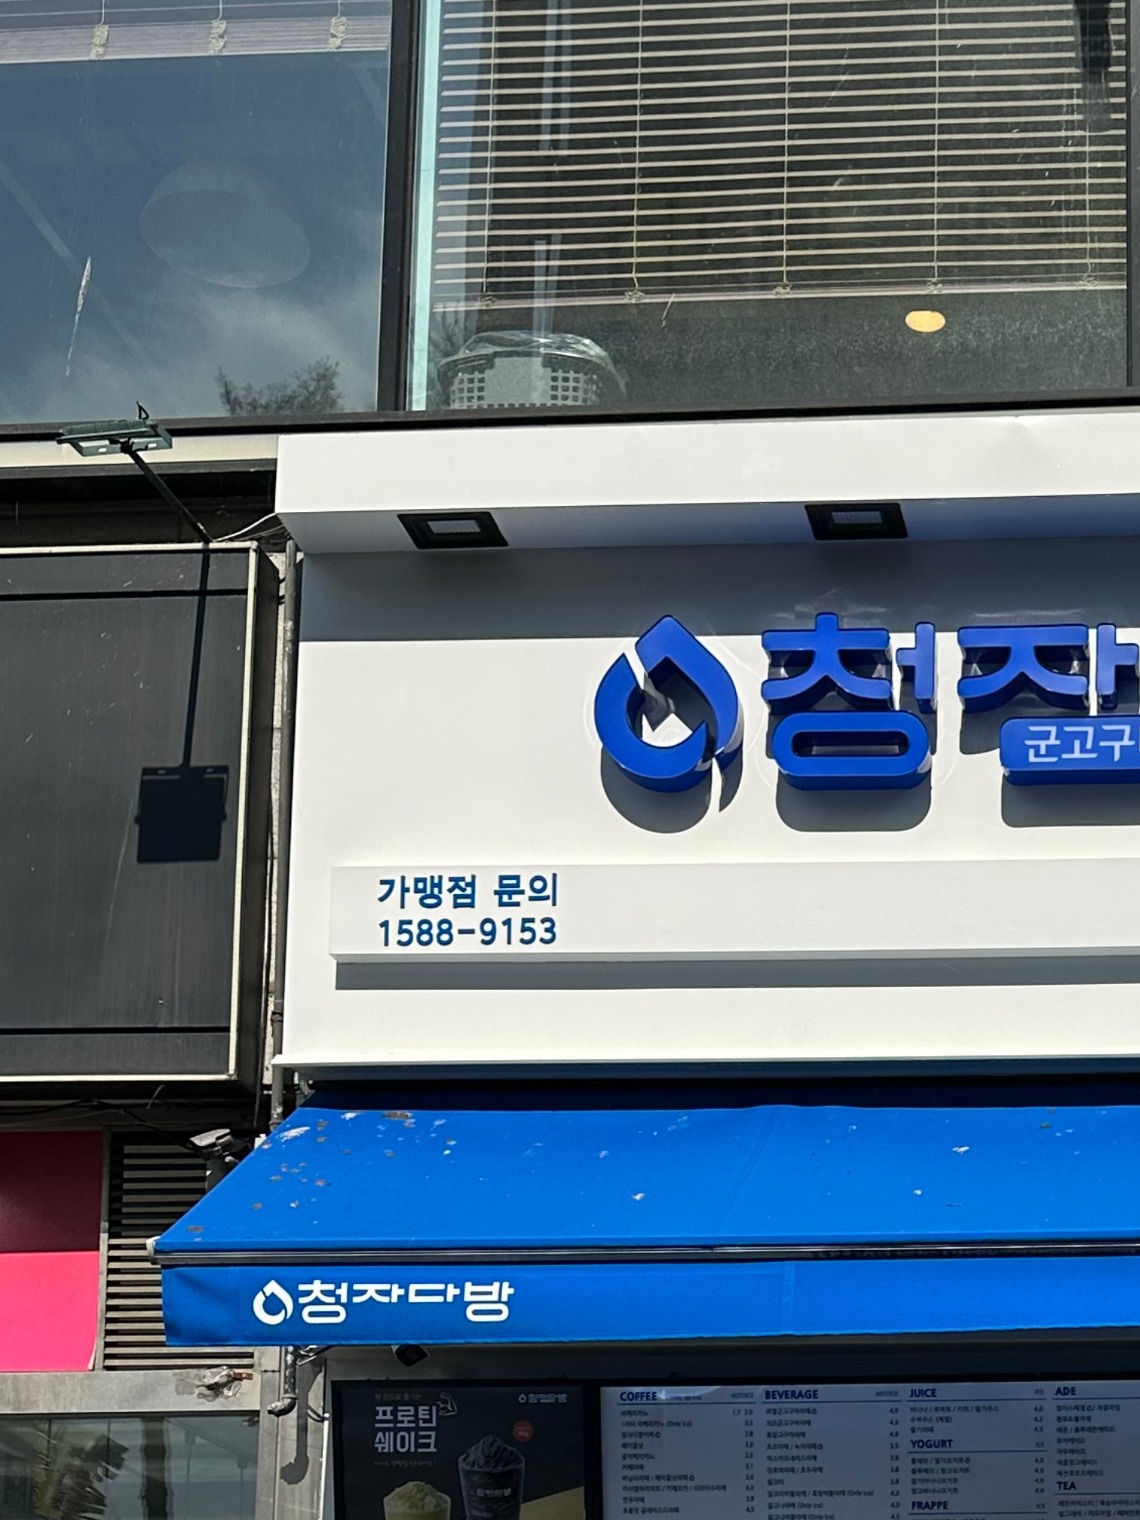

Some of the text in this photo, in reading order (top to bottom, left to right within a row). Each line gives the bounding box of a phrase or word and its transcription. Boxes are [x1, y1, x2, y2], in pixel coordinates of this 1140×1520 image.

[376, 871, 559, 910] 가맹점 문의
[377, 916, 558, 948] 1588-9153
[297, 1279, 516, 1325] 청자다방
[620, 1391, 658, 1401] COFFEE
[765, 1390, 818, 1400] BEVERAGE
[909, 1388, 937, 1398] JUICE
[1055, 1386, 1076, 1396] ADE
[374, 1405, 437, 1428] 프로틴
[374, 1431, 437, 1453] 쉐이크
[910, 1439, 953, 1449] YOGURT
[1056, 1481, 1077, 1491] TEA
[911, 1500, 949, 1510] FRAPPE
